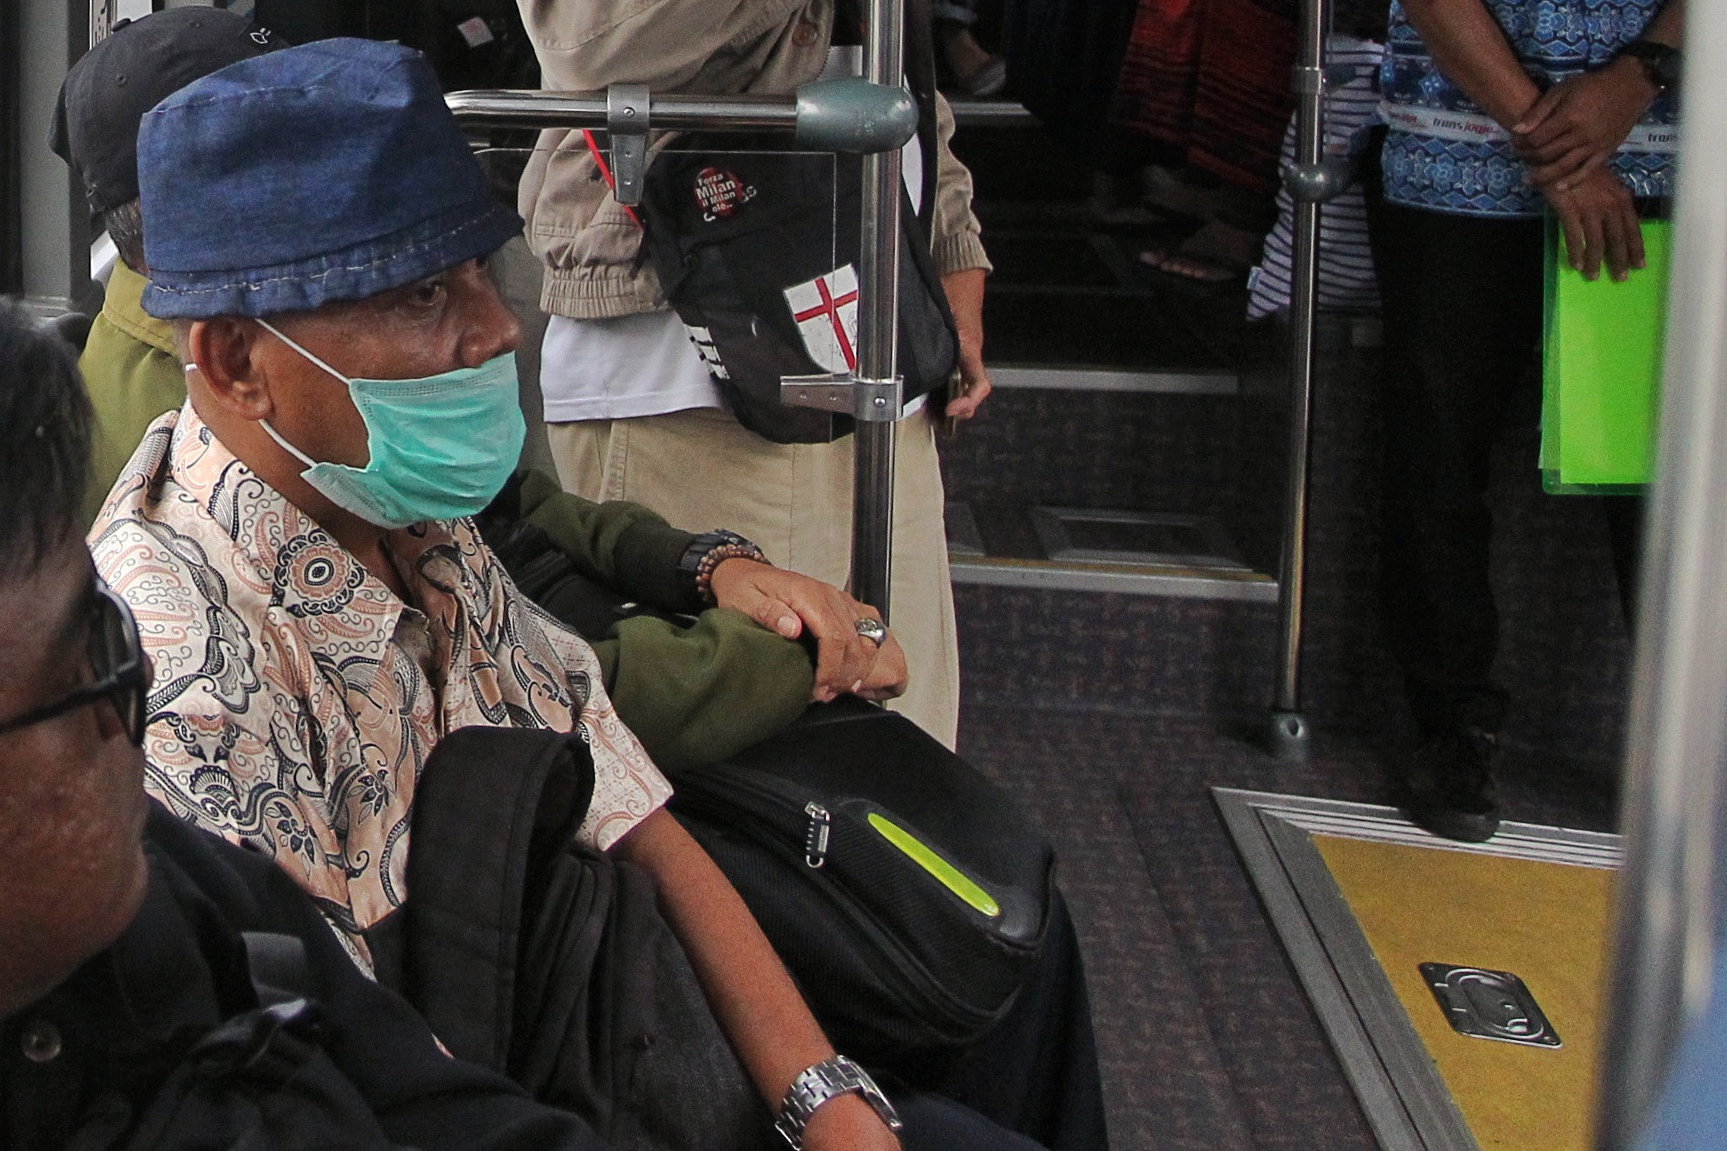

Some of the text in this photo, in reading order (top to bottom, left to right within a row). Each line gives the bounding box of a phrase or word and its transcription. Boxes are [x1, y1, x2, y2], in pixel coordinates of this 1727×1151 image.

[698, 173, 724, 186] Forza
[695, 180, 736, 200] Milan
[710, 191, 736, 204] Milan
